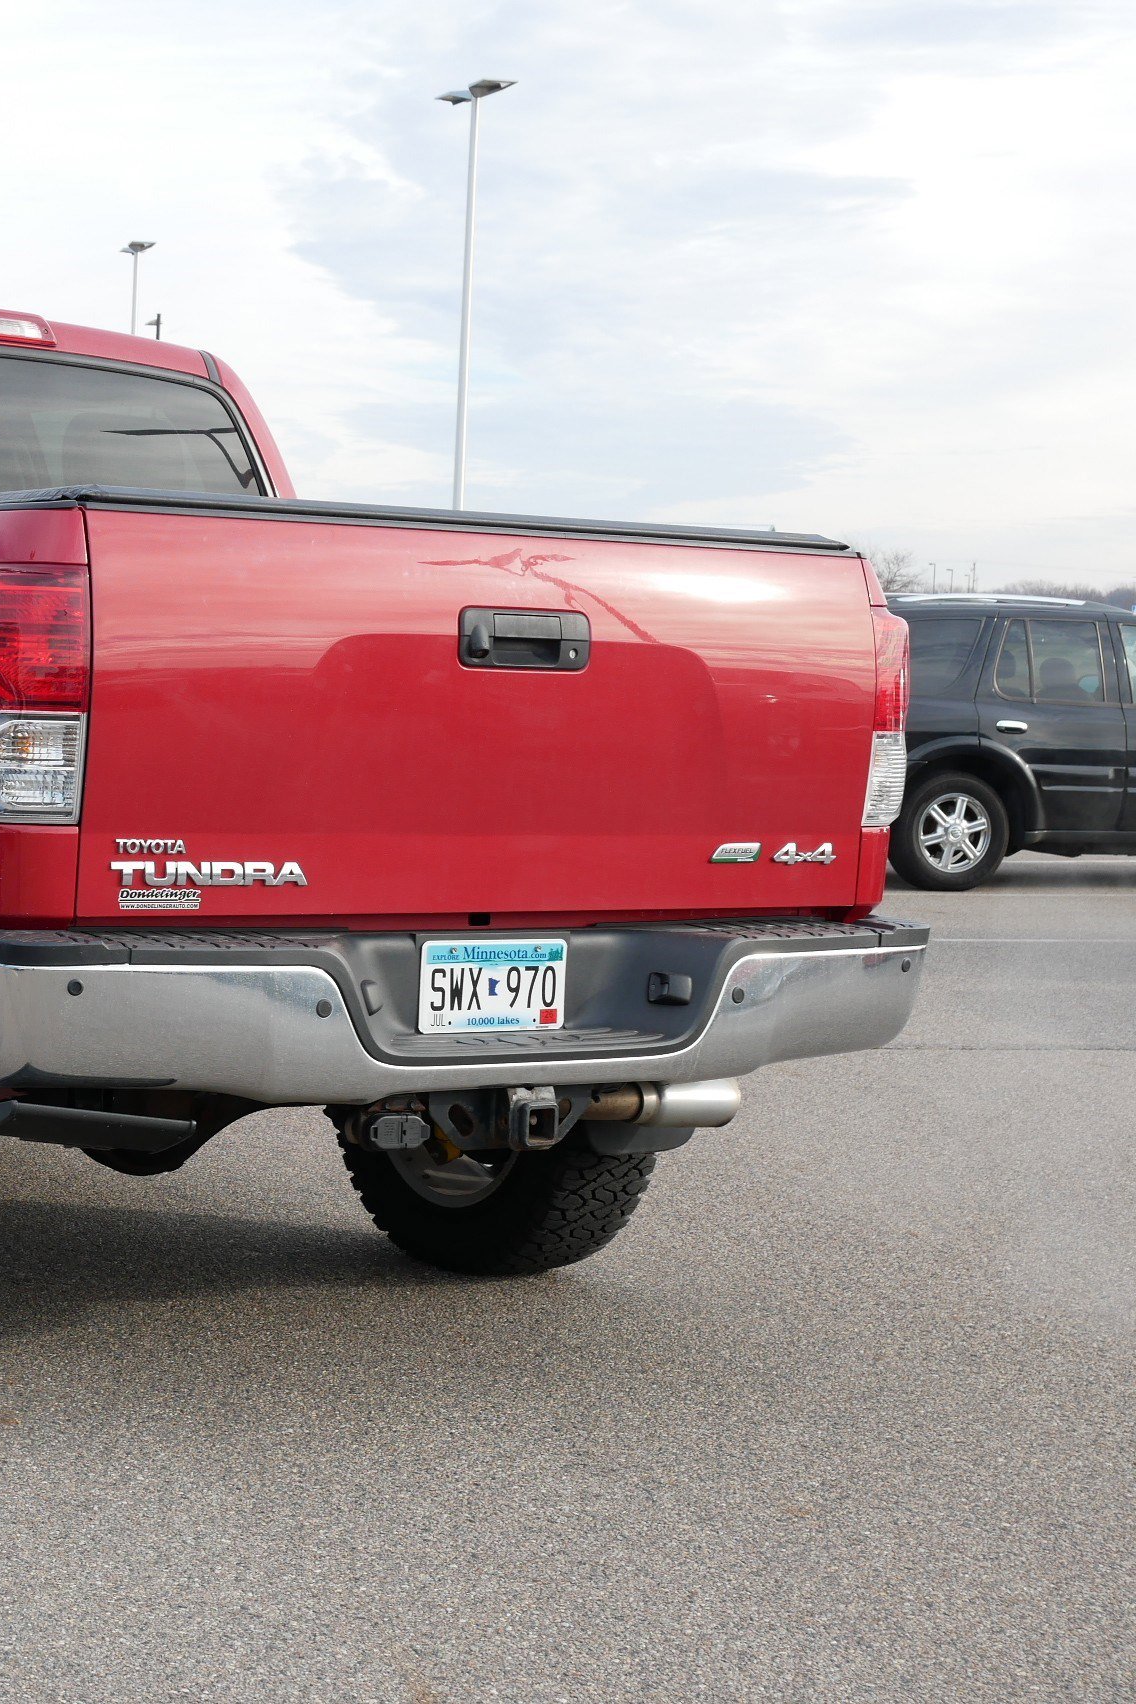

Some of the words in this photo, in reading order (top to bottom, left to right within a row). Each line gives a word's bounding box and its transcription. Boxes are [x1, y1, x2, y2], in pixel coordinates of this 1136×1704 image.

[115, 838, 187, 854] TOYOTA
[773, 842, 837, 865] 4x4
[110, 861, 308, 886] TUNDRA
[119, 888, 199, 901] Dondelinger
[430, 967, 483, 1011] SWX
[506, 965, 556, 1009] 970
[430, 1013, 446, 1027] JUL
[467, 1017, 495, 1026] 10,000
[497, 1016, 520, 1025] lakes
